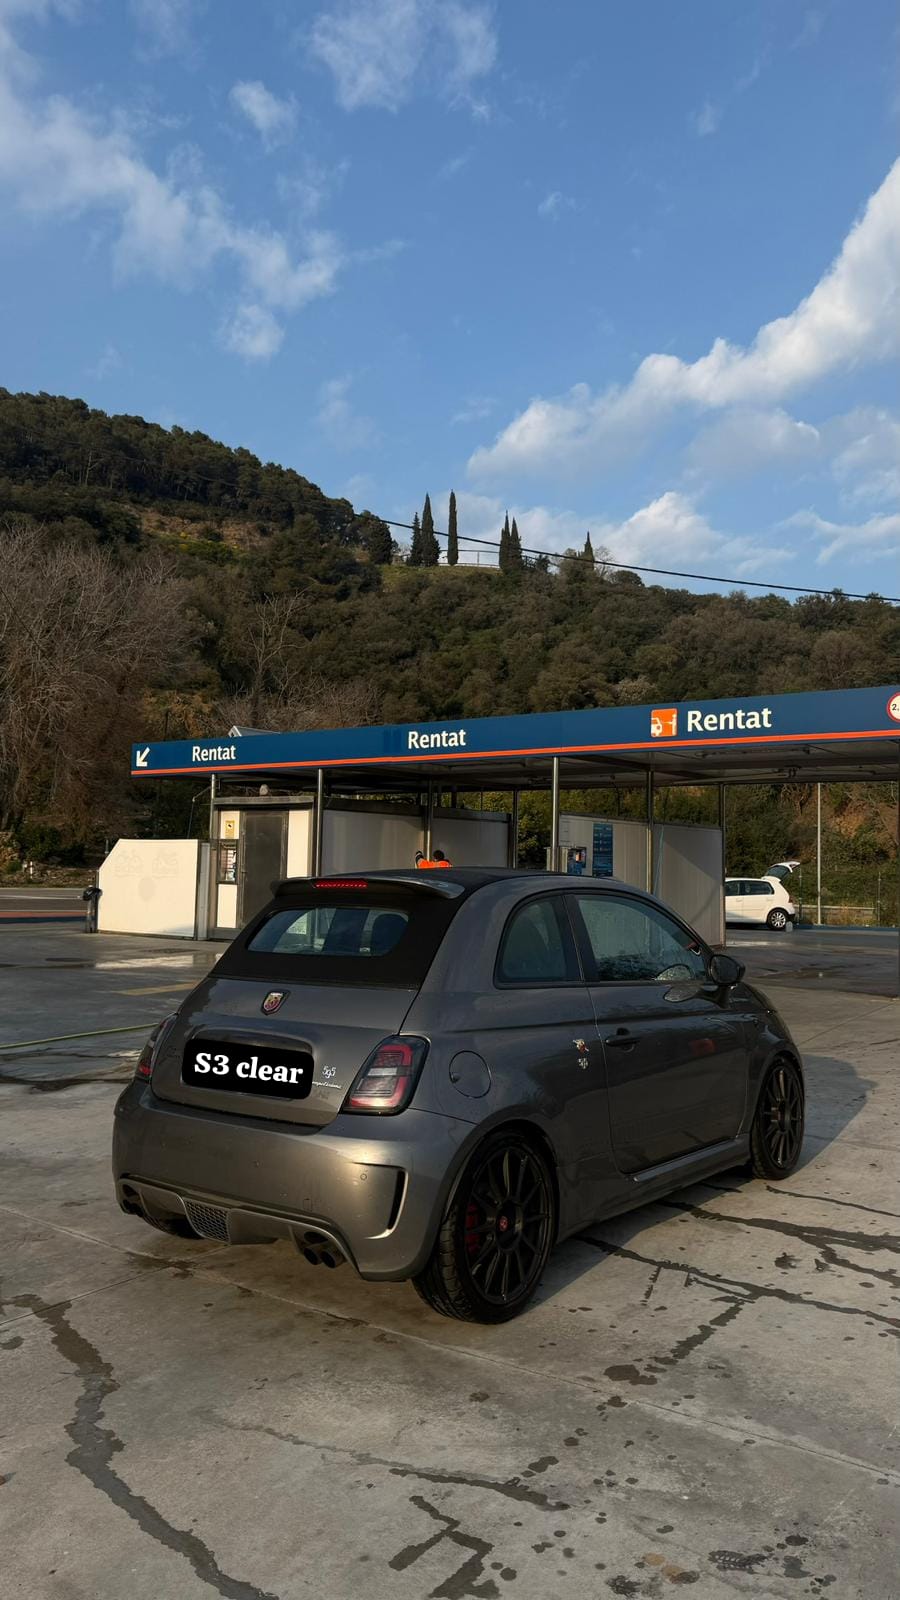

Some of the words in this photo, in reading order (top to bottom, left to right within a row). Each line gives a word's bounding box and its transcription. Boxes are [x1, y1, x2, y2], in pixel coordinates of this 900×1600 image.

[687, 707, 773, 732] Rentat
[407, 729, 467, 750] Rentat
[192, 745, 236, 762] Rentat
